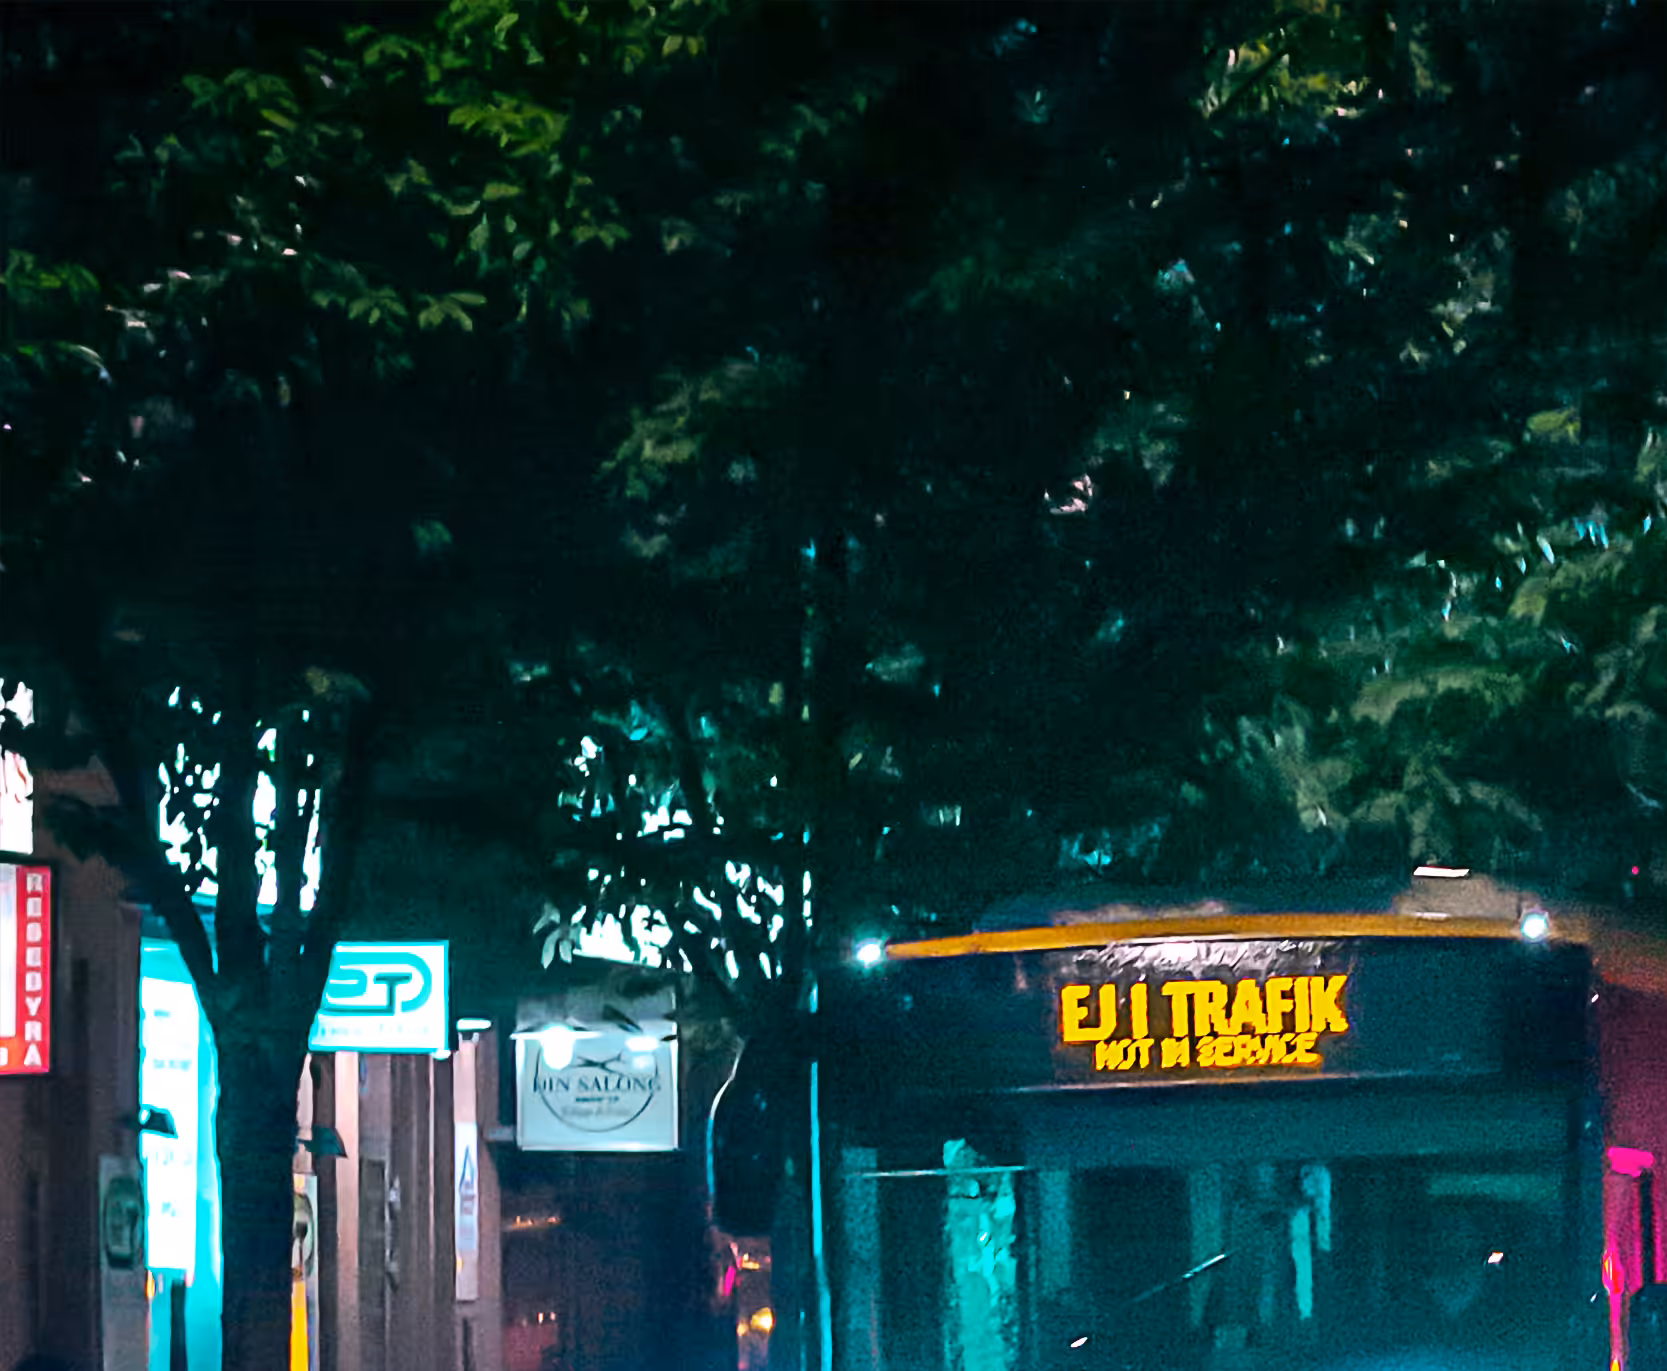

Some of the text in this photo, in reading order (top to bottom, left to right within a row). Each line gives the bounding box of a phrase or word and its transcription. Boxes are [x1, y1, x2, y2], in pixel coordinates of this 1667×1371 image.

[1061, 983, 1118, 1042] EJ
[1161, 974, 1350, 1037] TRAFIK
[1095, 1037, 1155, 1071] NOT
[1196, 1032, 1322, 1067] SERVICE
[577, 1075, 662, 1093] SALONG
